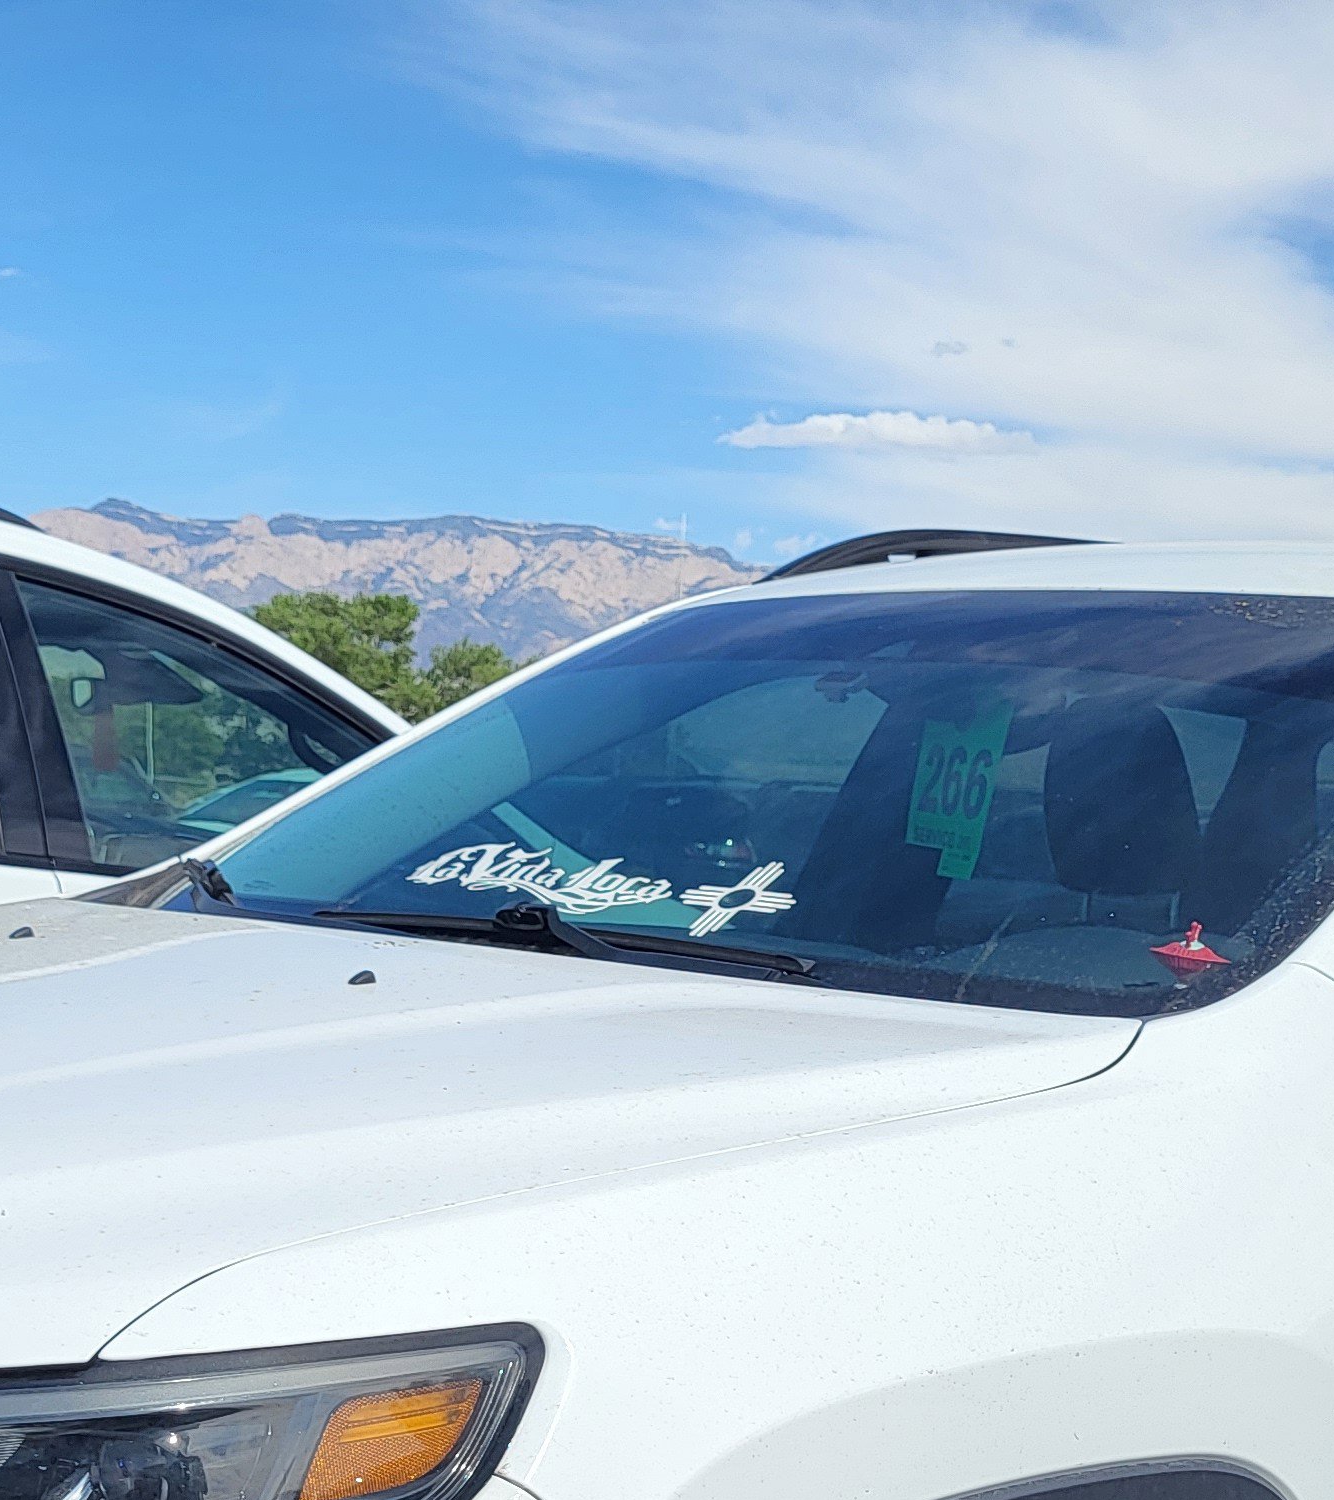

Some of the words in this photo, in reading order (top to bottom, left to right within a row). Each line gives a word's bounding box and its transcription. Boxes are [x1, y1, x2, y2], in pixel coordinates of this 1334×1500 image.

[918, 745, 993, 820] 266
[461, 841, 566, 892] Vida
[560, 857, 673, 904] Loca
